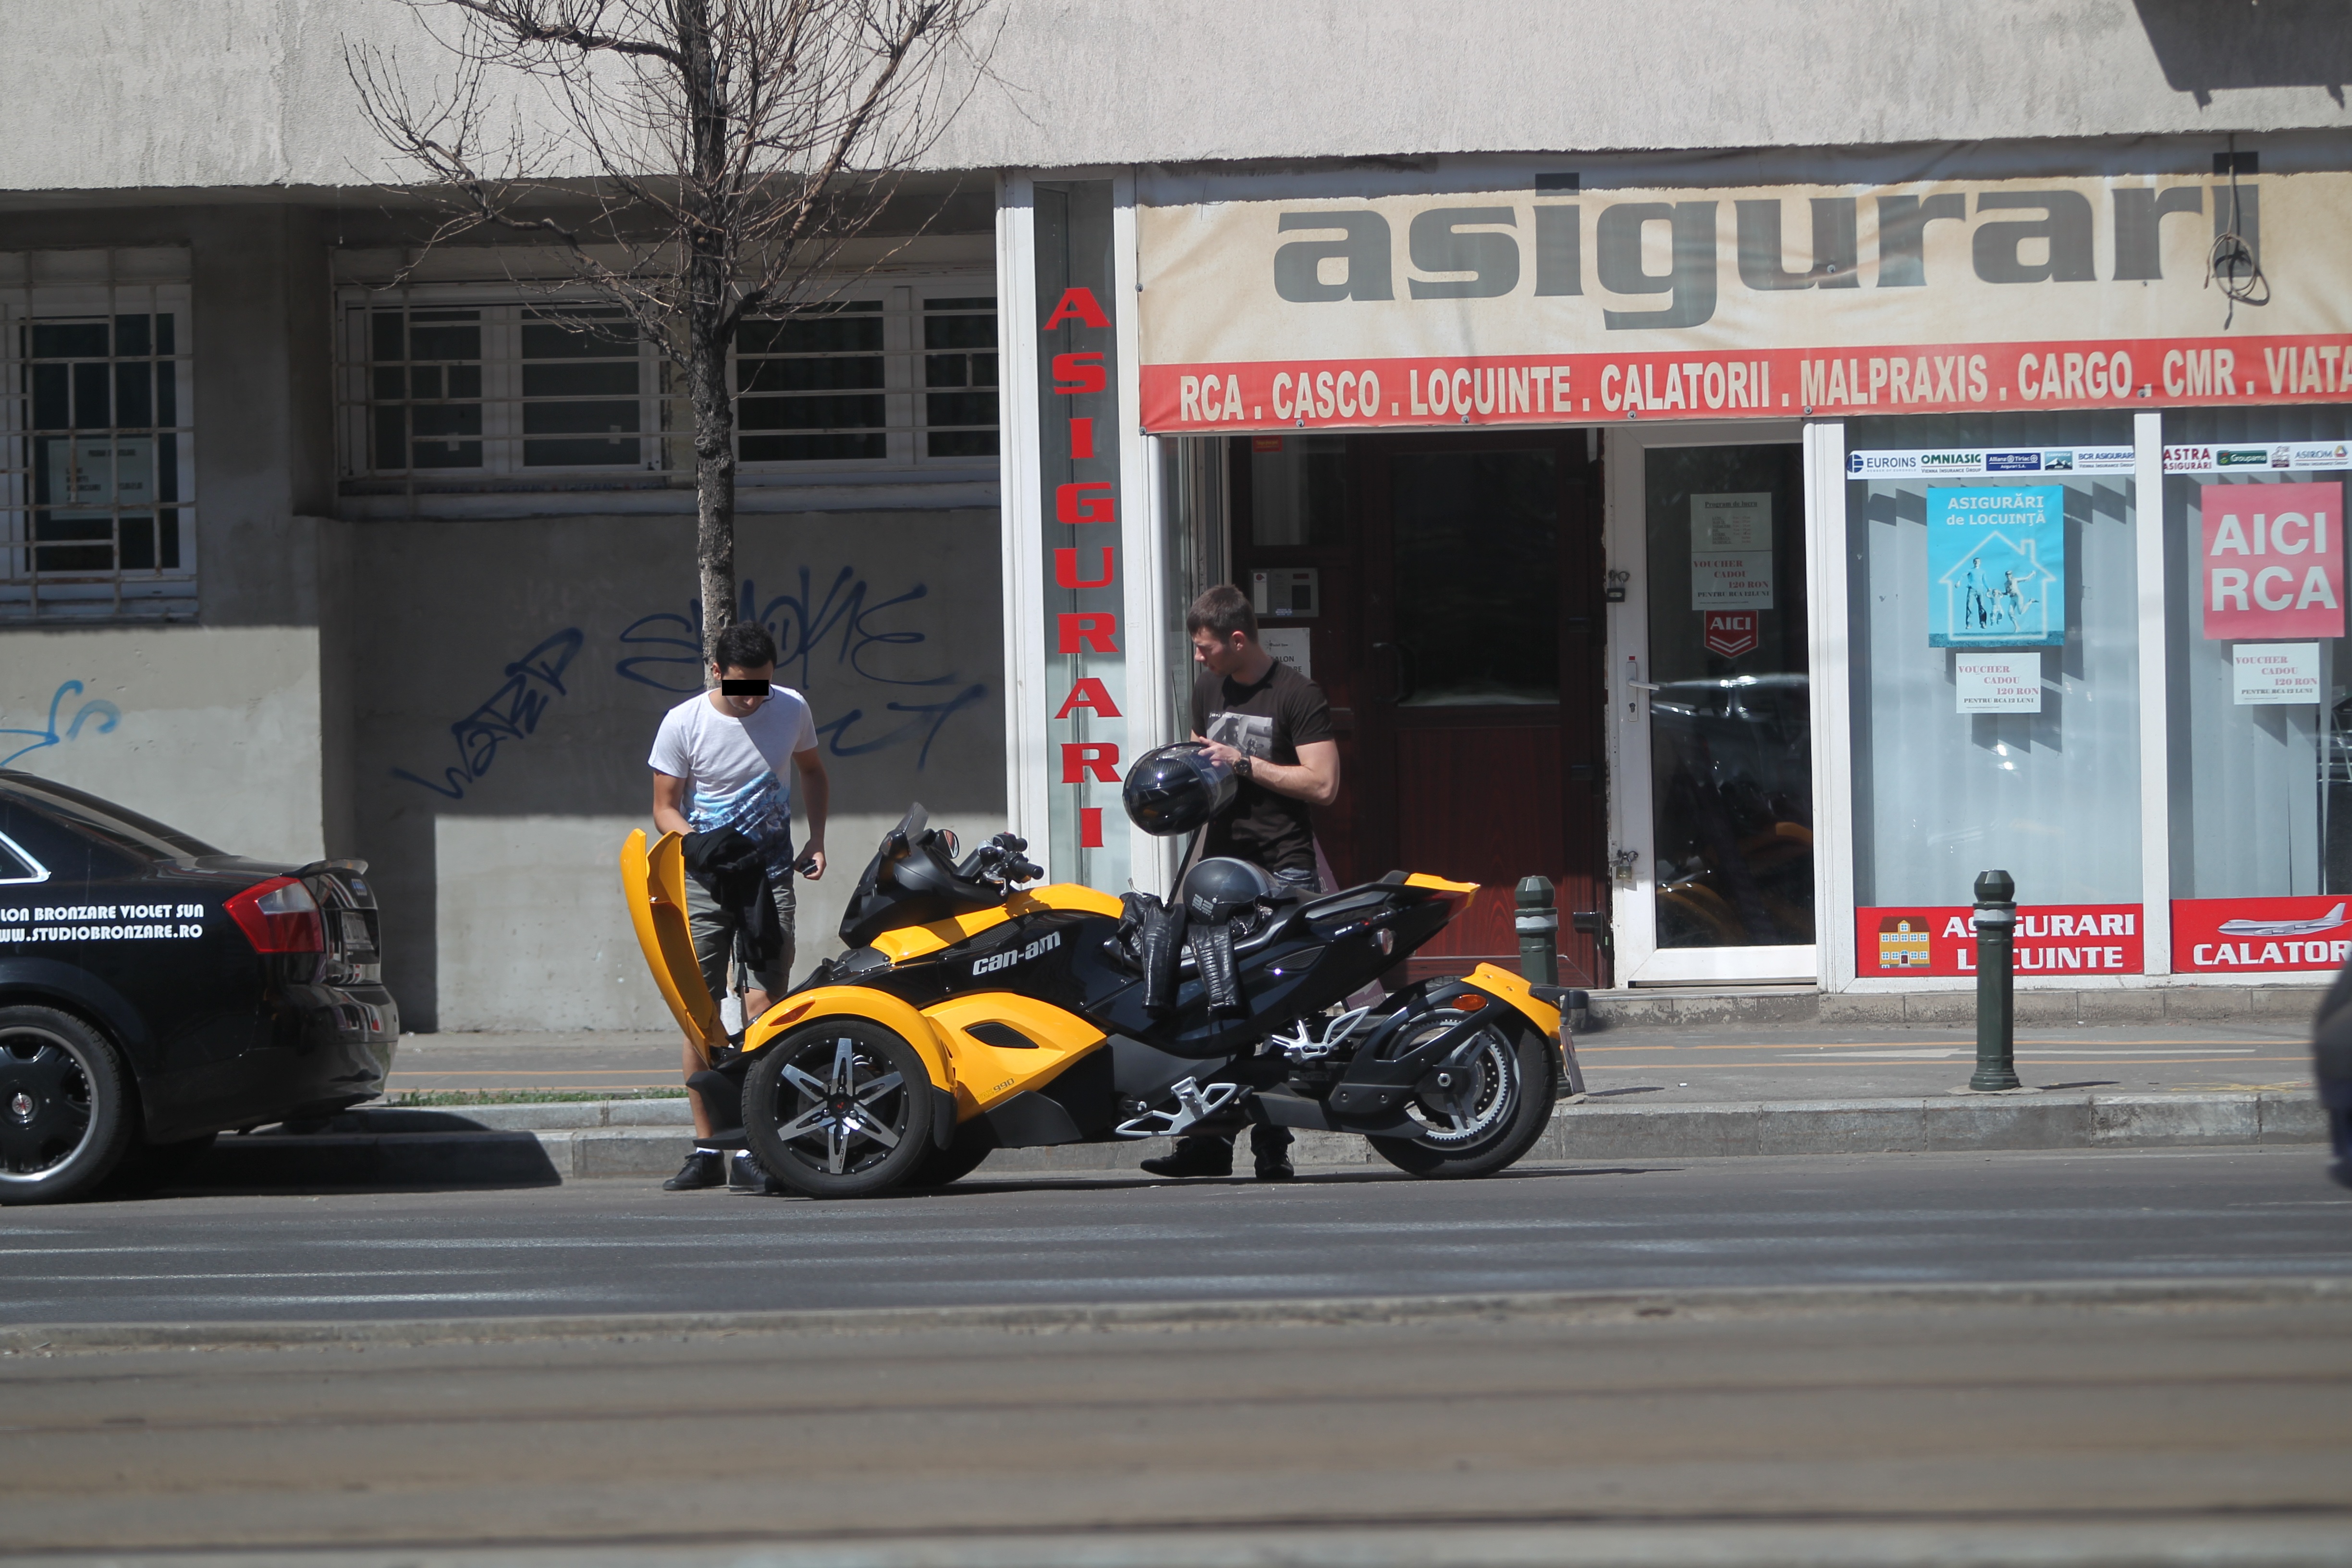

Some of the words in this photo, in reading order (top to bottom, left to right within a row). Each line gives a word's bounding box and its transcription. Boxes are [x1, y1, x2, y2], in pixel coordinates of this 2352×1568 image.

[1274, 152, 2259, 330] asigurari
[1180, 374, 1245, 422] RCA
[1272, 369, 1380, 420] CASCO
[1410, 366, 1572, 416] LOCUINTE
[1600, 361, 1769, 412] CALATORII
[1801, 354, 1987, 406] MALPRAXIS
[2018, 350, 2133, 402] CARGO
[2162, 348, 2237, 398] CMR
[1921, 453, 1981, 464] OMNIASIG
[2163, 448, 2211, 461] ASTRA
[2230, 453, 2266, 463] Groupama
[2295, 450, 2333, 458] ASIROM
[1867, 457, 1916, 467] EUROINS
[1948, 493, 2044, 510] ASIGURĂRI
[1947, 514, 1964, 526] de
[2210, 512, 2327, 556] AICI
[1042, 287, 1123, 848] ASIGURARI
[2212, 566, 2338, 611] RCA
[1710, 617, 1751, 630] AICI
[2235, 656, 2288, 664] VOUCHER
[2261, 667, 2299, 675] CADOU
[1984, 676, 2021, 685] CADOU
[2275, 678, 2292, 686] 120
[2295, 677, 2317, 686] RON
[0, 908, 29, 922] LON
[34, 906, 116, 921] BRONZARE
[120, 905, 172, 919] VIOLET
[176, 904, 204, 918] SUN
[1942, 914, 2134, 938] AGURARI
[973, 931, 1060, 975] can-am
[1957, 946, 2123, 969] LUINTE
[993, 1078, 1015, 1091] 990
